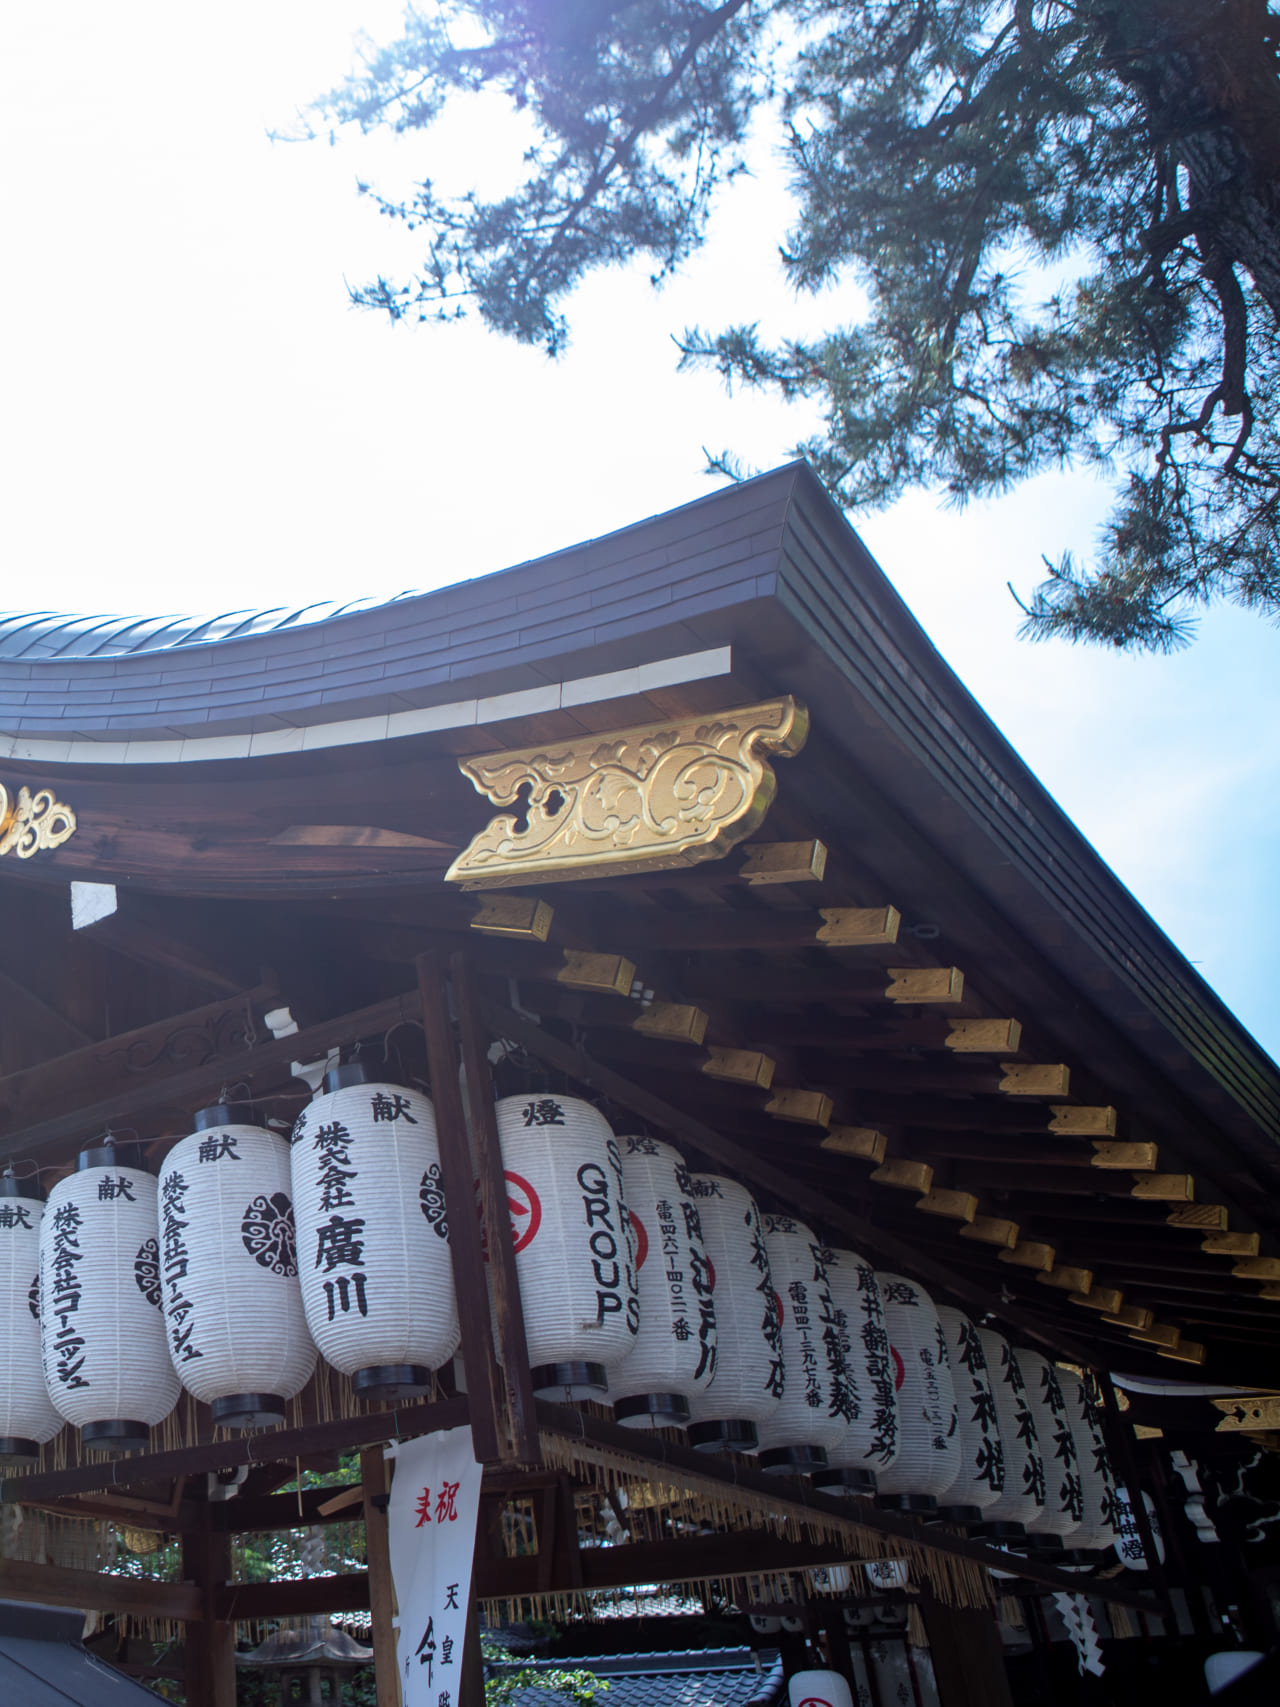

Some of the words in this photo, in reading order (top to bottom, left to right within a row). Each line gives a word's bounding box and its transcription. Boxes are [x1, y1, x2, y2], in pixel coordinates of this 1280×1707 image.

[371, 1093, 419, 1125] 献
[199, 1134, 242, 1163] 献
[98, 1175, 137, 1202] 献
[577, 1163, 622, 1327] GROUP
